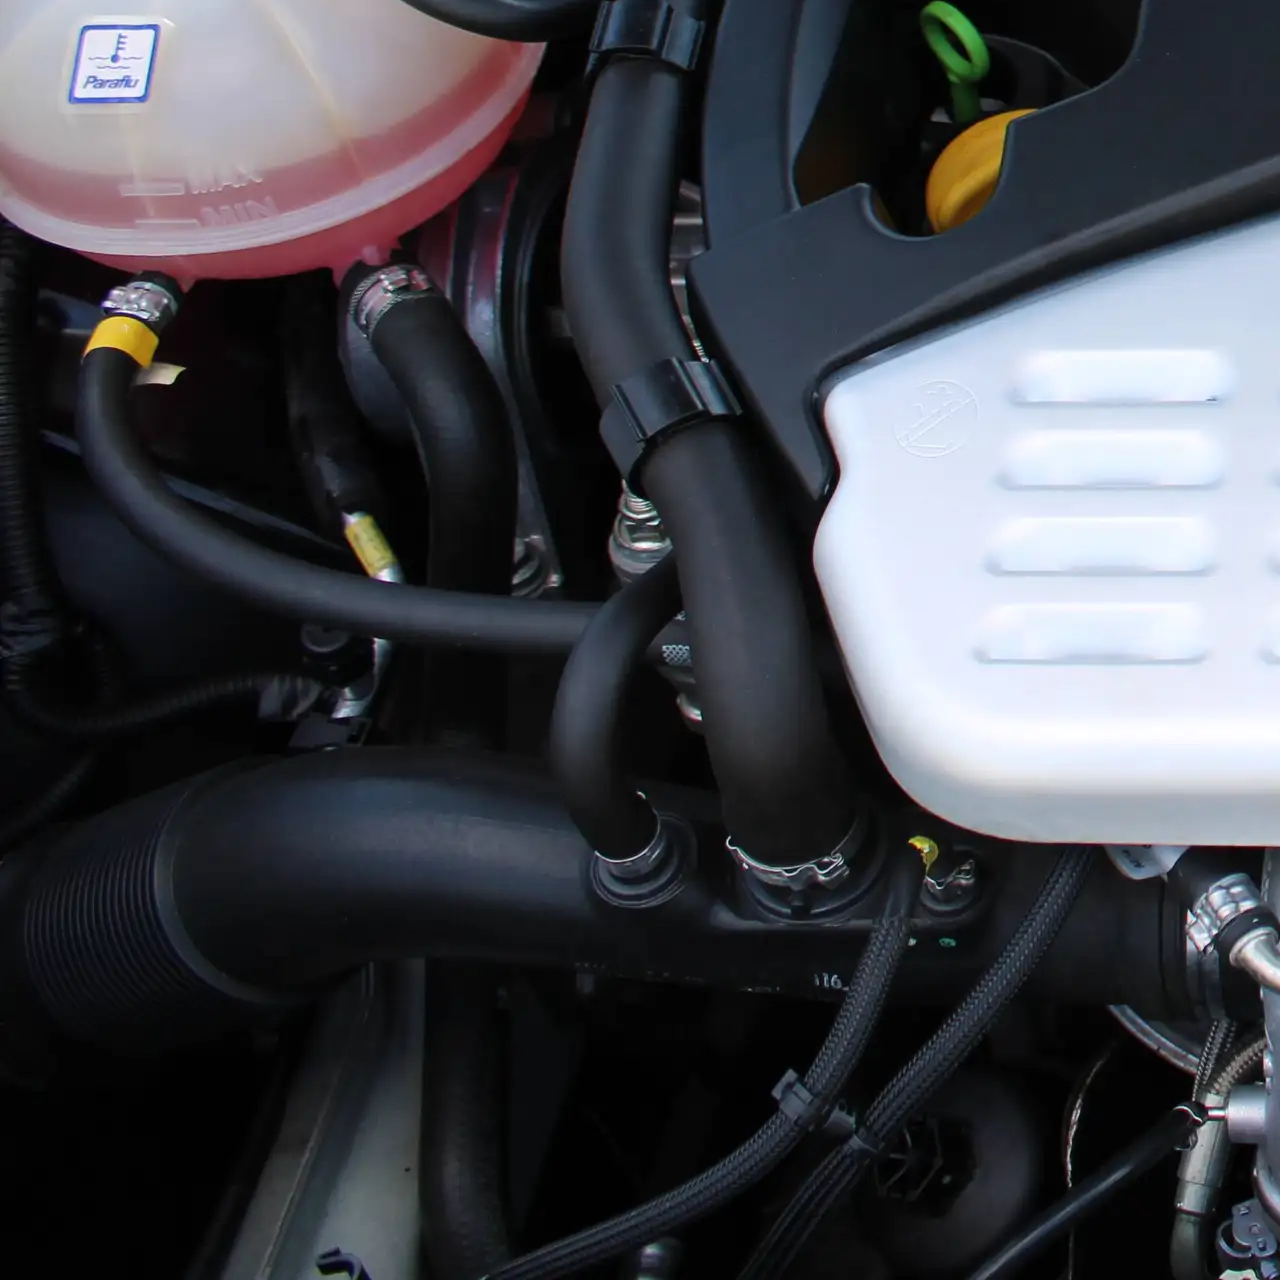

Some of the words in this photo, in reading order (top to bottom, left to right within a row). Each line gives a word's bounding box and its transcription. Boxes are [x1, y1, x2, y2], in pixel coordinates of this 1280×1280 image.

[82, 73, 141, 92] Paraflu
[190, 163, 263, 195] MAX
[200, 195, 278, 226] MIN
